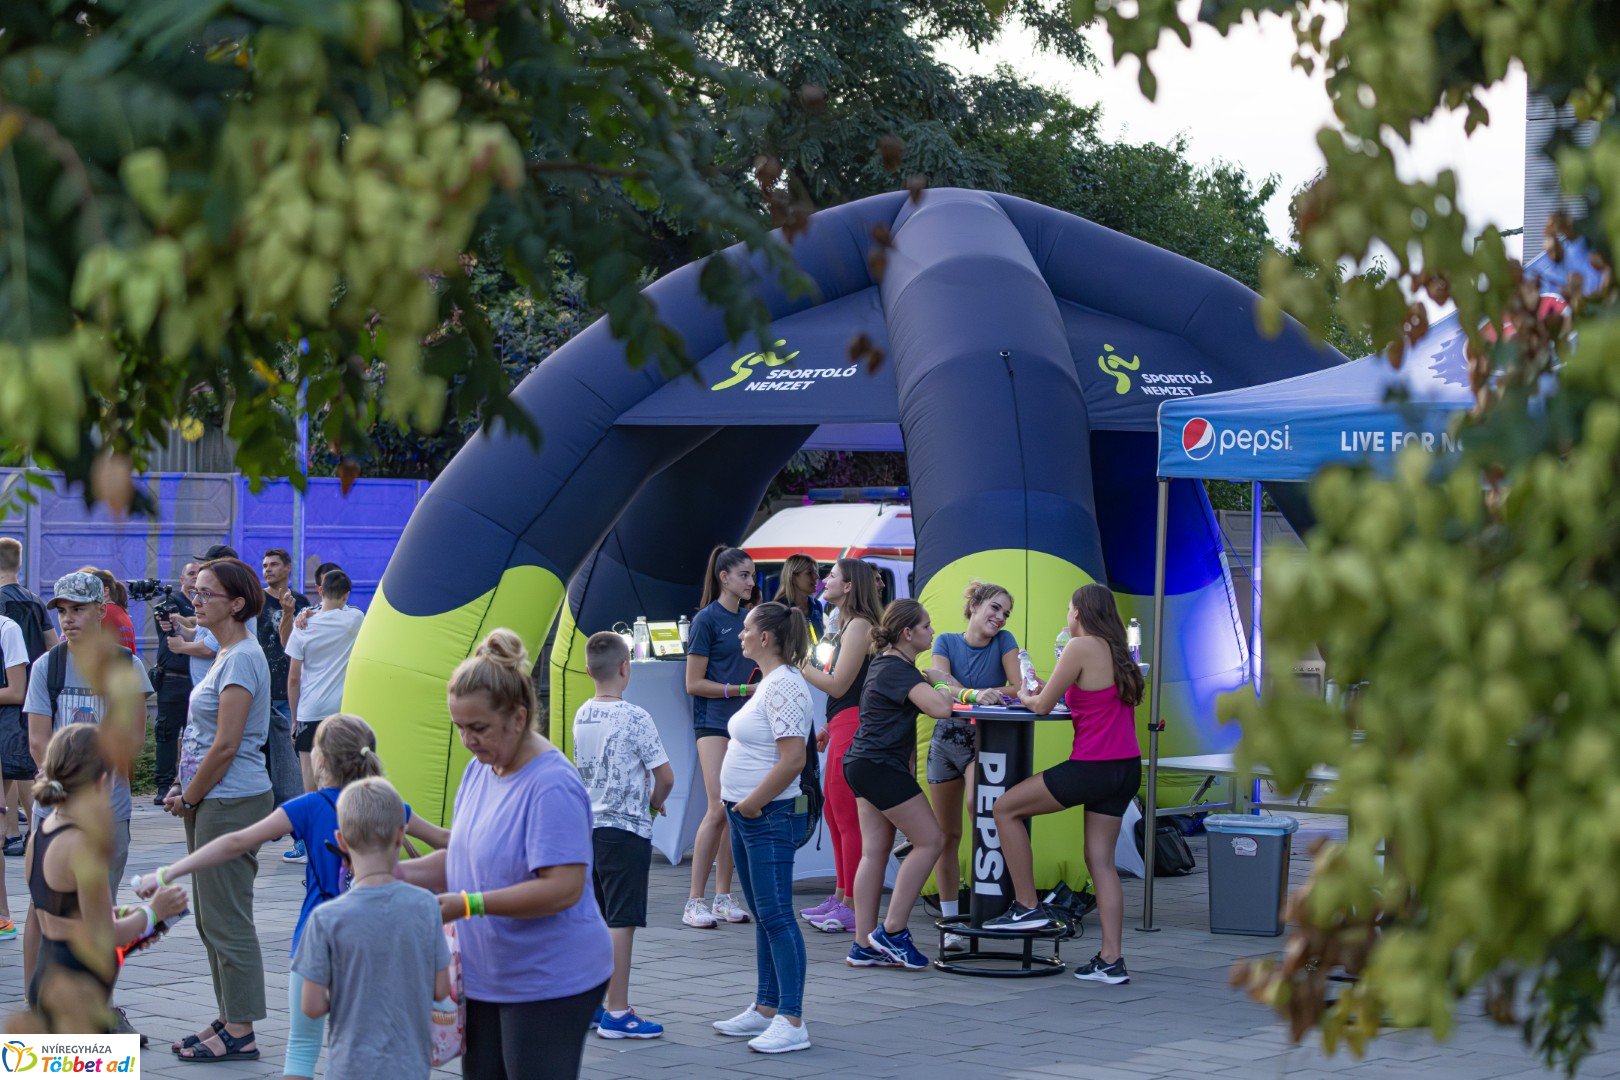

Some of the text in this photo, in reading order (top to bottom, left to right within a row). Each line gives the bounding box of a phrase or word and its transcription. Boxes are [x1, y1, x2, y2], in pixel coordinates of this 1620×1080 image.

[766, 364, 858, 380] SPORTOLÓ
[1141, 370, 1213, 384] SPORTOLÓ
[744, 380, 815, 391] NEMZET
[1140, 386, 1194, 396] NEMZET
[1219, 424, 1290, 456] pepsi
[1341, 431, 1385, 452] LIVE
[974, 751, 1007, 896] PEPSI
